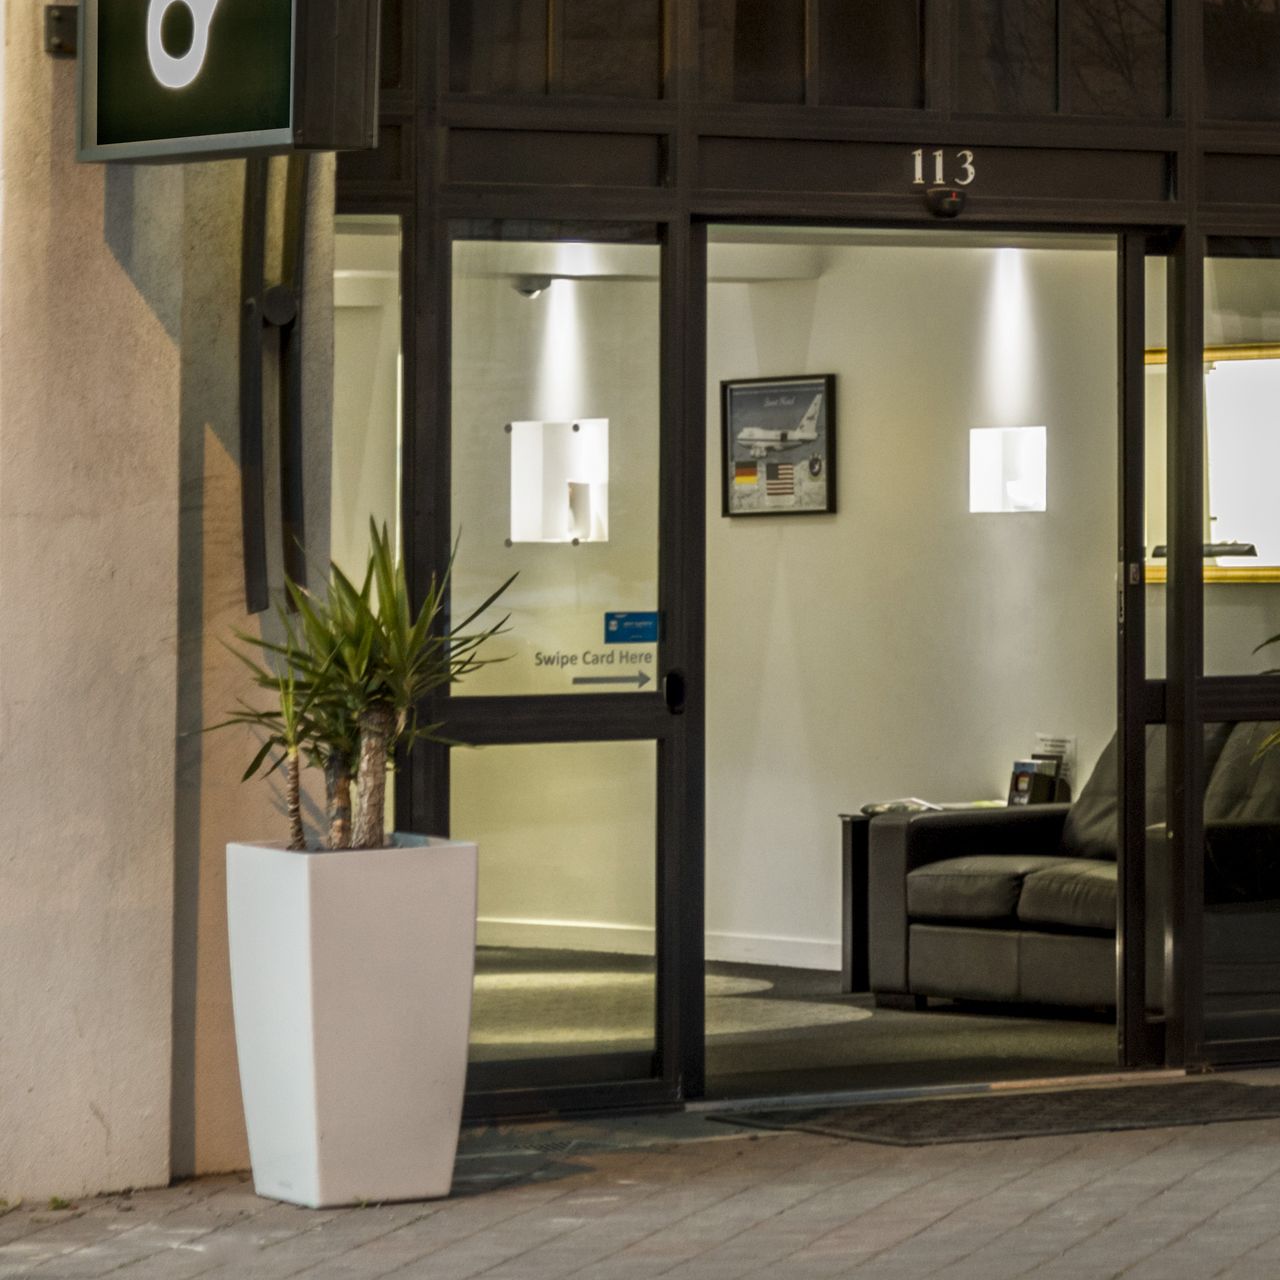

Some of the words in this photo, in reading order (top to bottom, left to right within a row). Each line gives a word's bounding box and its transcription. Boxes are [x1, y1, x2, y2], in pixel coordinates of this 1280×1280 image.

[911, 148, 976, 186] 113
[534, 651, 578, 668] Swipe
[582, 650, 615, 665] Card
[619, 651, 652, 664] Here
